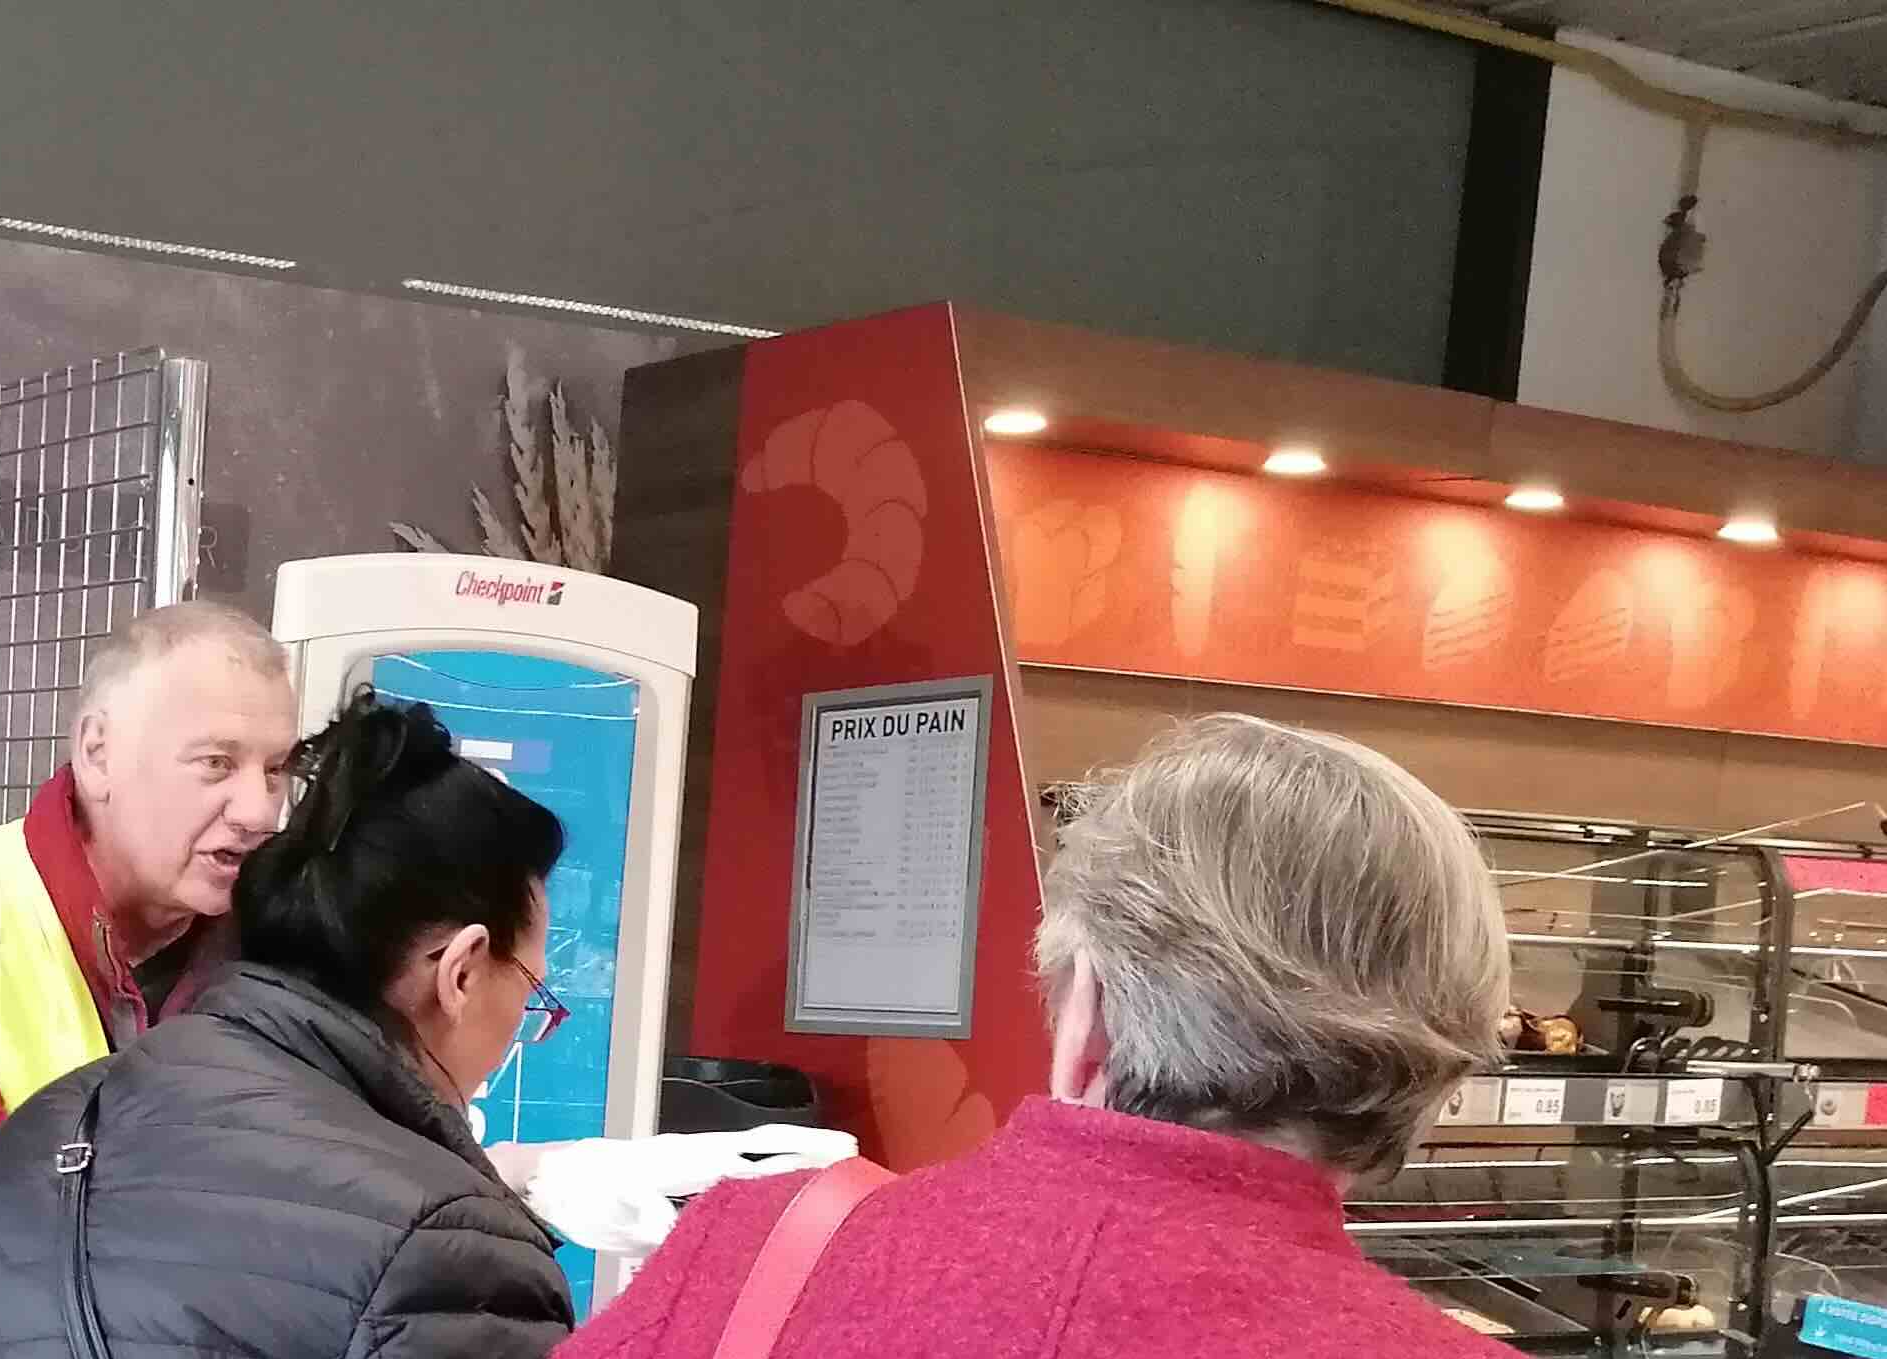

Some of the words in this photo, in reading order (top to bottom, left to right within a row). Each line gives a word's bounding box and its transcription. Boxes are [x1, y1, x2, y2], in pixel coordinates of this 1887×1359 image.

[456, 571, 544, 606] Checkpoint
[831, 716, 877, 742] PRIX
[883, 713, 910, 737] DU
[916, 709, 965, 734] PAIN
